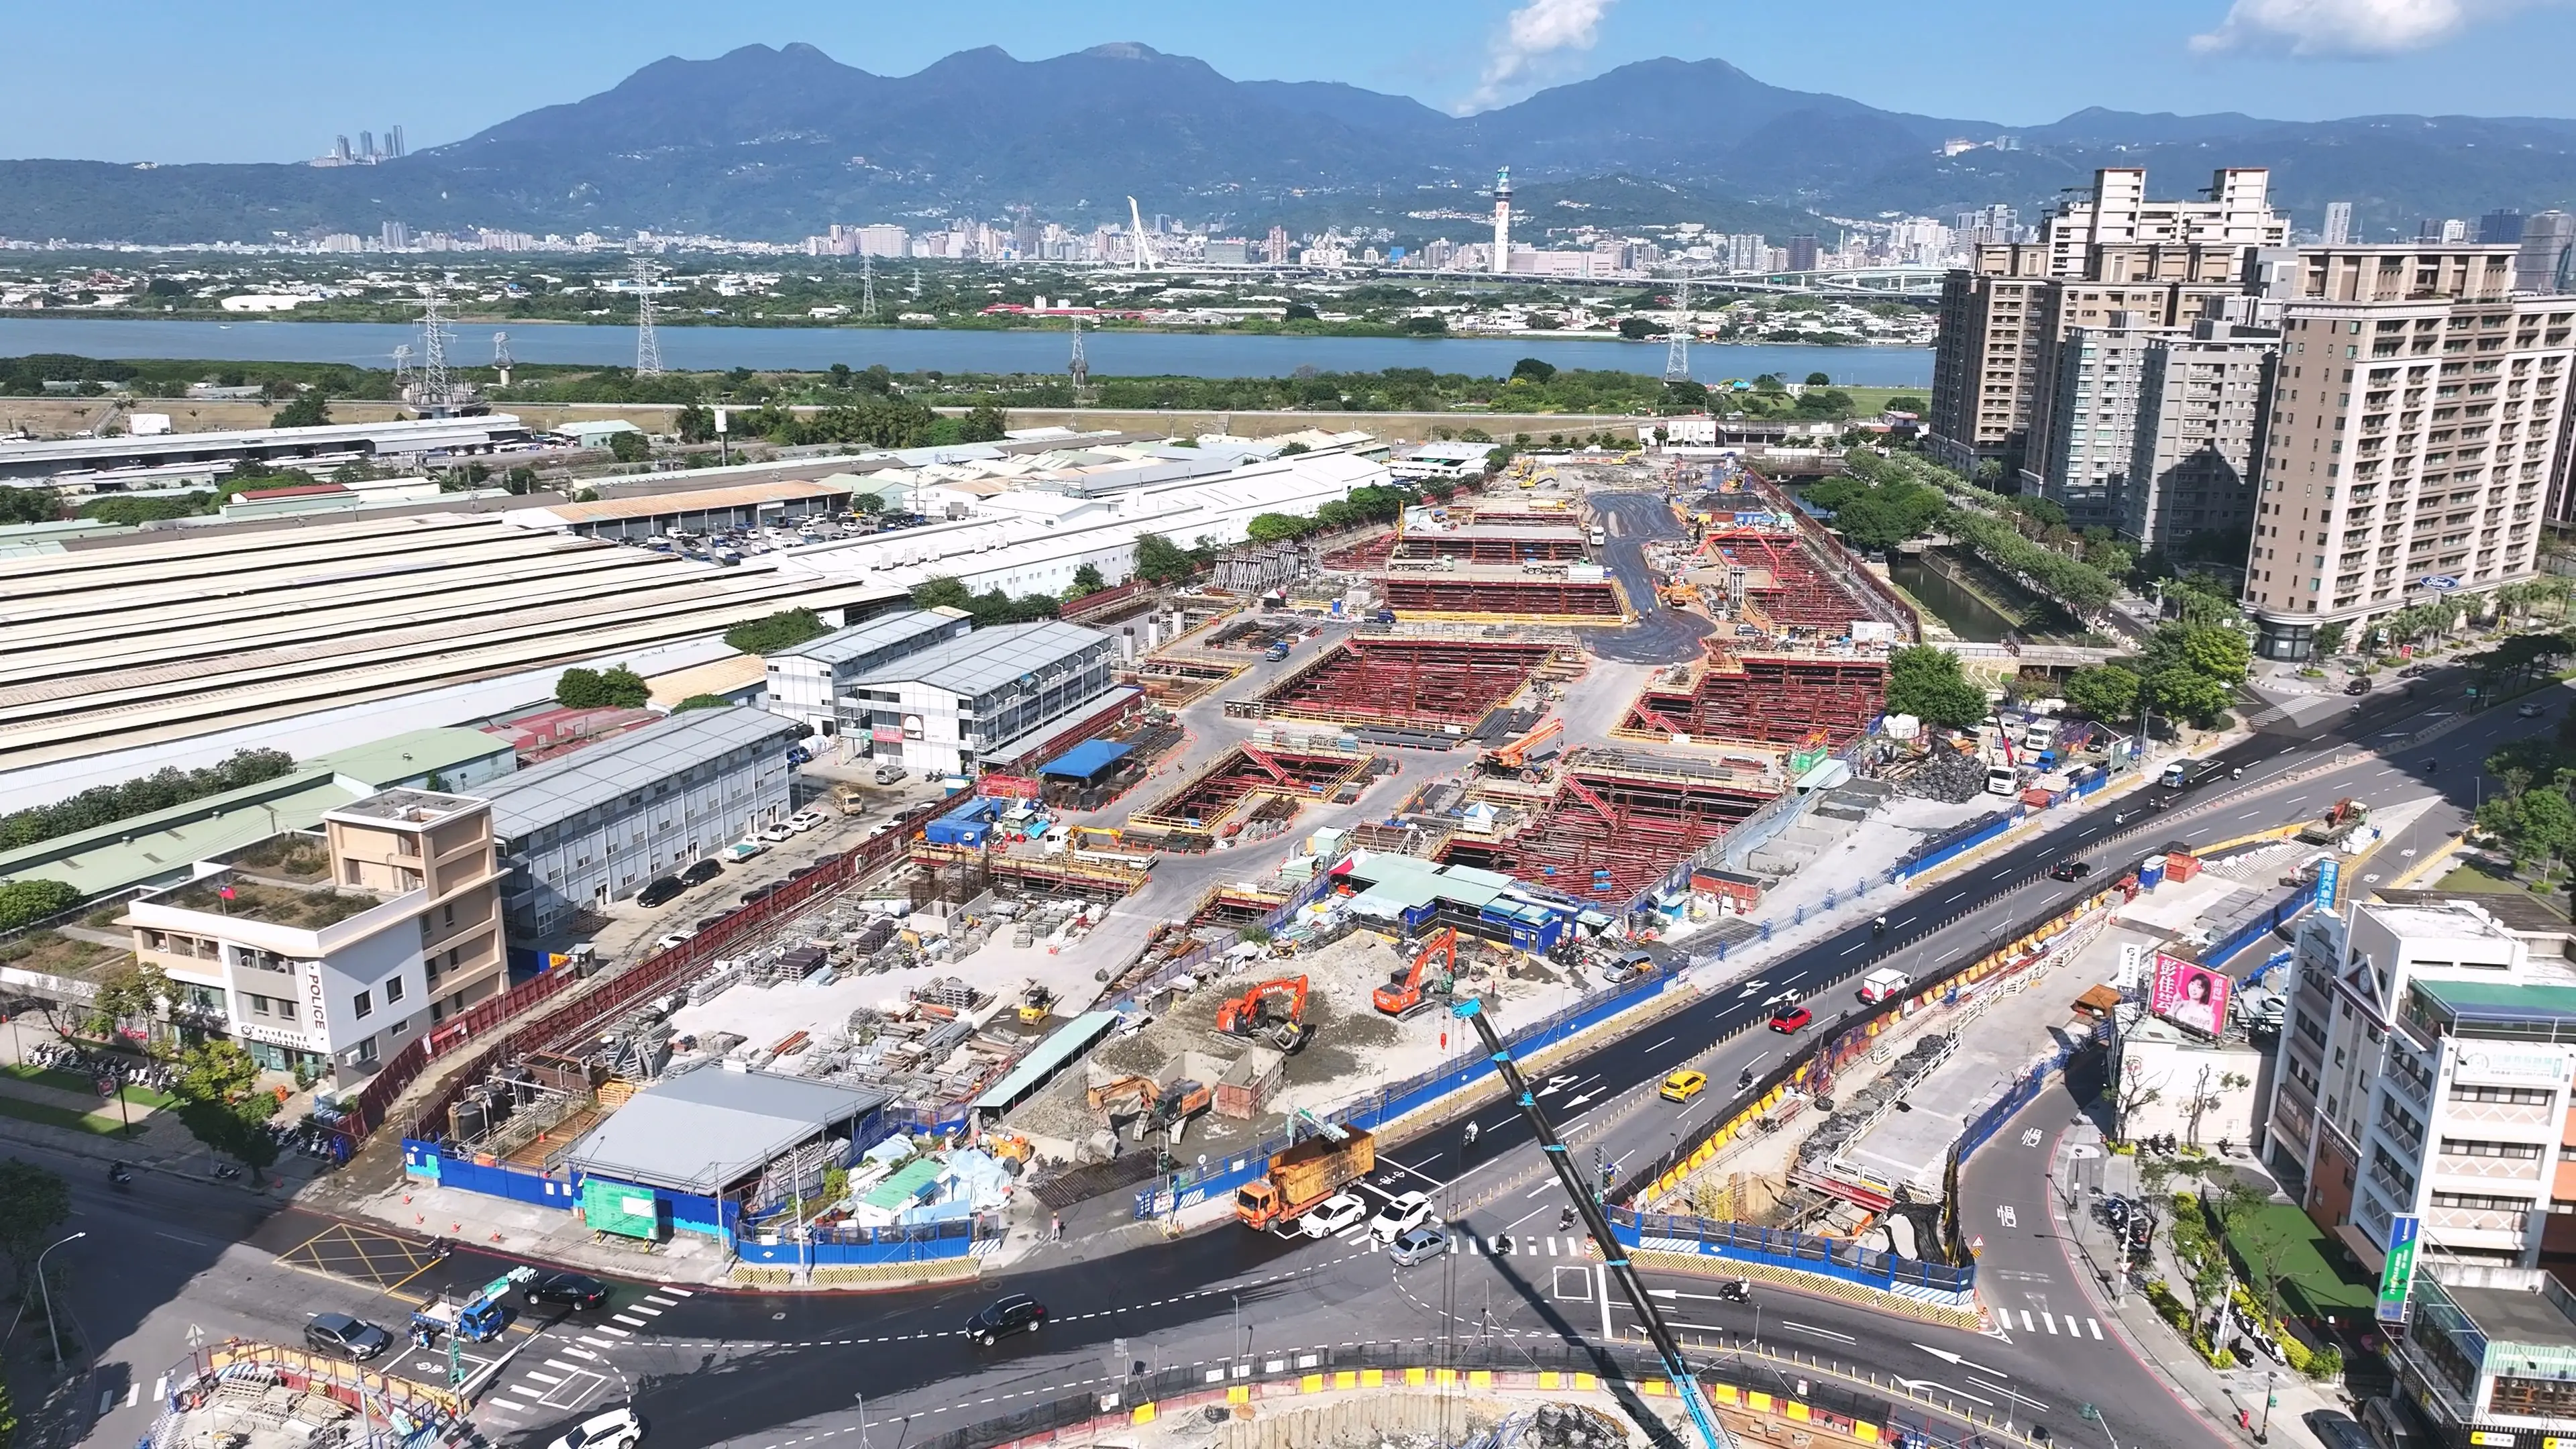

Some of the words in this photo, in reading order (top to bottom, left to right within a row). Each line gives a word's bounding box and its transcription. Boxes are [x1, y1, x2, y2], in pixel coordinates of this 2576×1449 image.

[2426, 576, 2451, 588] Ford
[2155, 959, 2178, 1012] 彭佳芸
[308, 973, 326, 1030] POLICE
[2021, 1127, 2043, 1148] 慢
[1996, 1205, 2017, 1228] 慢
